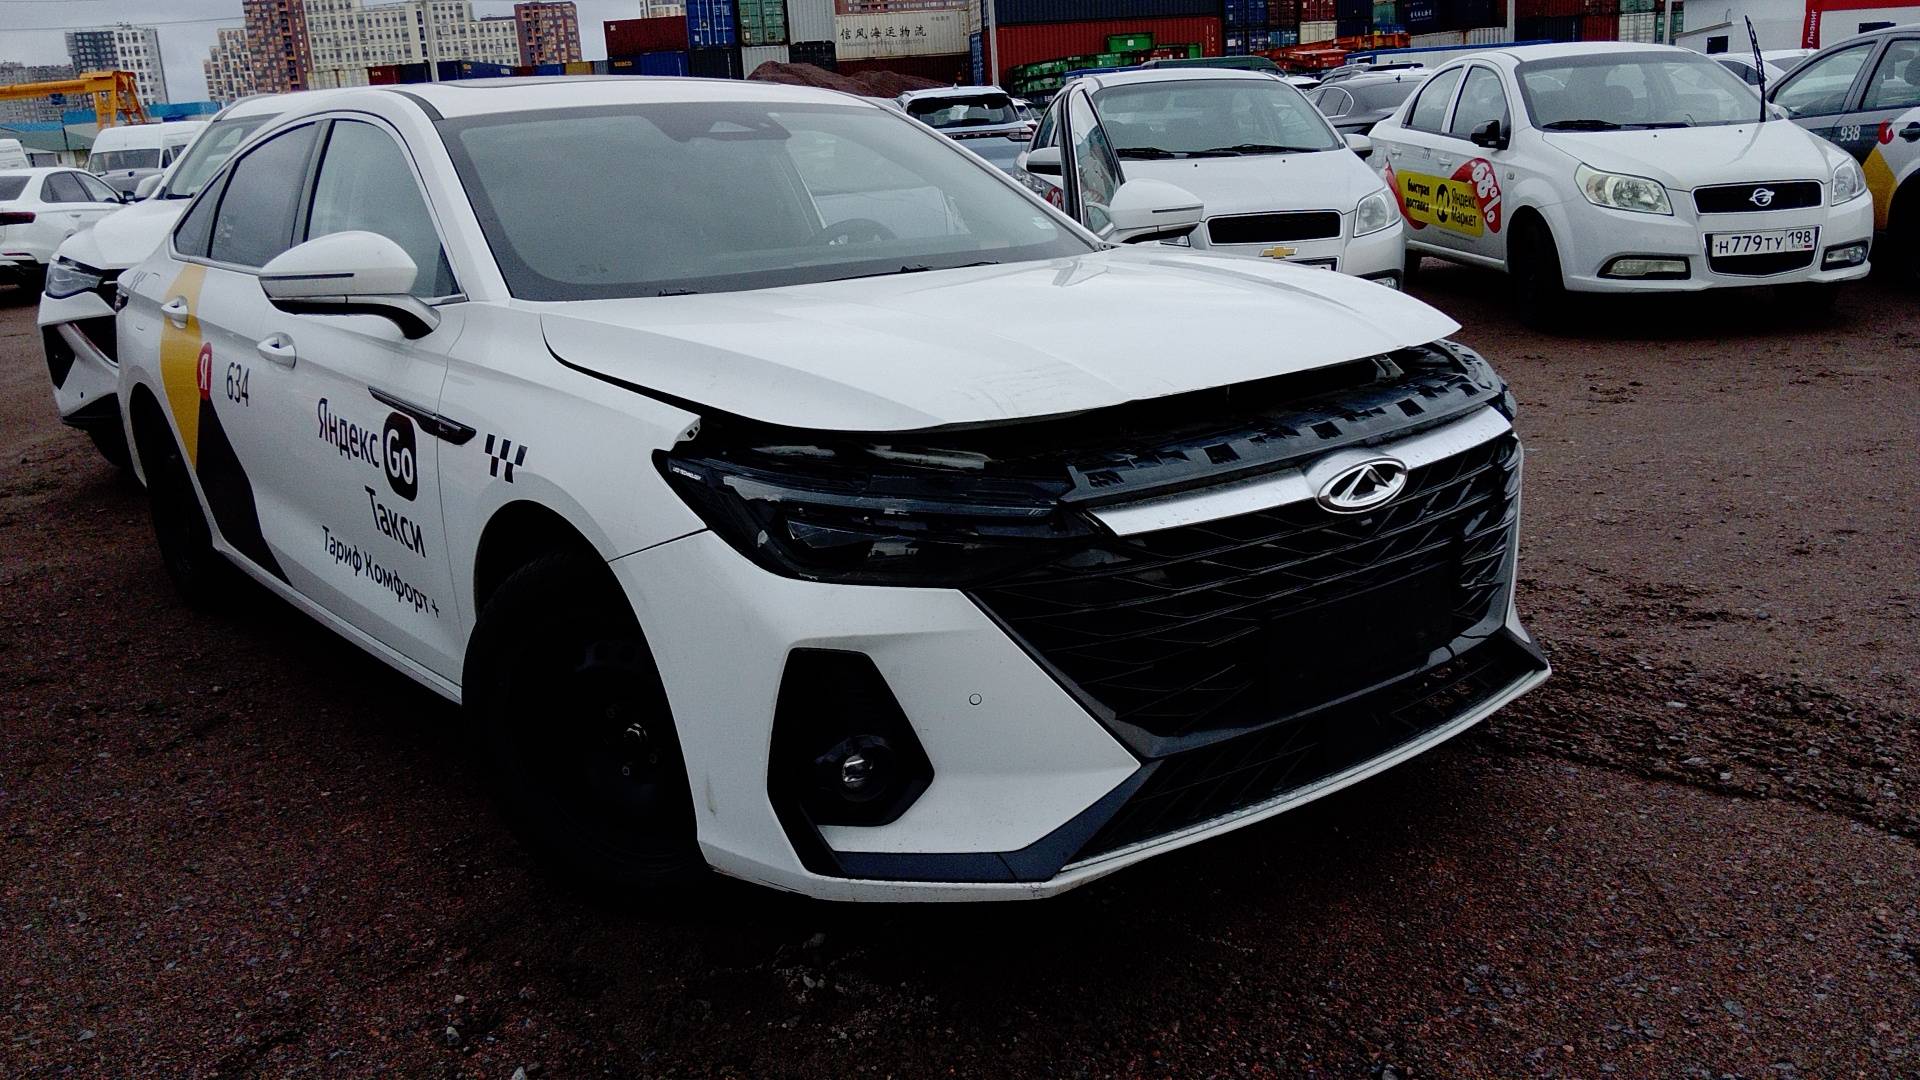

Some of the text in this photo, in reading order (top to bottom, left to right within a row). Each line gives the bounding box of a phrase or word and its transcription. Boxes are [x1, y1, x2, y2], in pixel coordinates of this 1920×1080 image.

[840, 24, 927, 41] 信风海运物流
[1840, 125, 1860, 142] 938
[1451, 187, 1476, 209] Яндекс
[1450, 205, 1477, 227] Маркет
[1787, 231, 1811, 245] 198
[199, 354, 210, 391] Я
[226, 361, 249, 407] 634
[317, 397, 415, 486] Яндекс Go
[365, 485, 426, 559] Такси
[322, 525, 362, 579] Тариф
[363, 551, 430, 614] Комфорт
